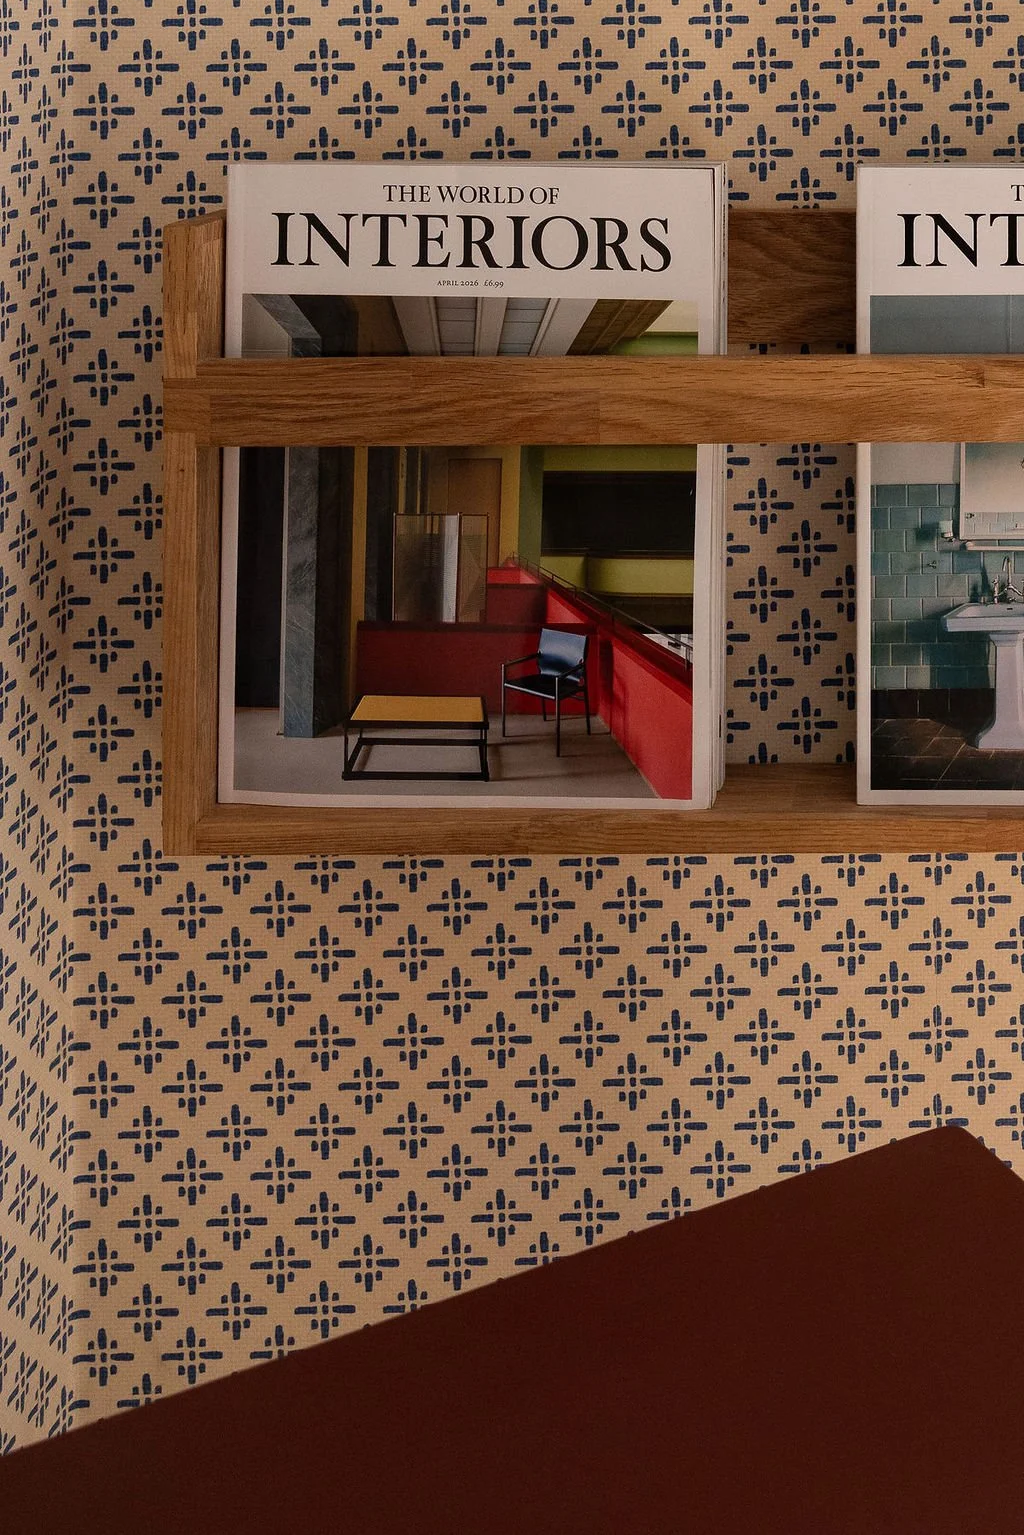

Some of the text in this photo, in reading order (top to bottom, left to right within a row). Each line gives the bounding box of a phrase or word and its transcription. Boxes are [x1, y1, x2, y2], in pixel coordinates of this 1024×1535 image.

[382, 184, 560, 205] THE WORLD OF
[270, 212, 672, 273] INTERIORS
[484, 280, 504, 289] £6.99
